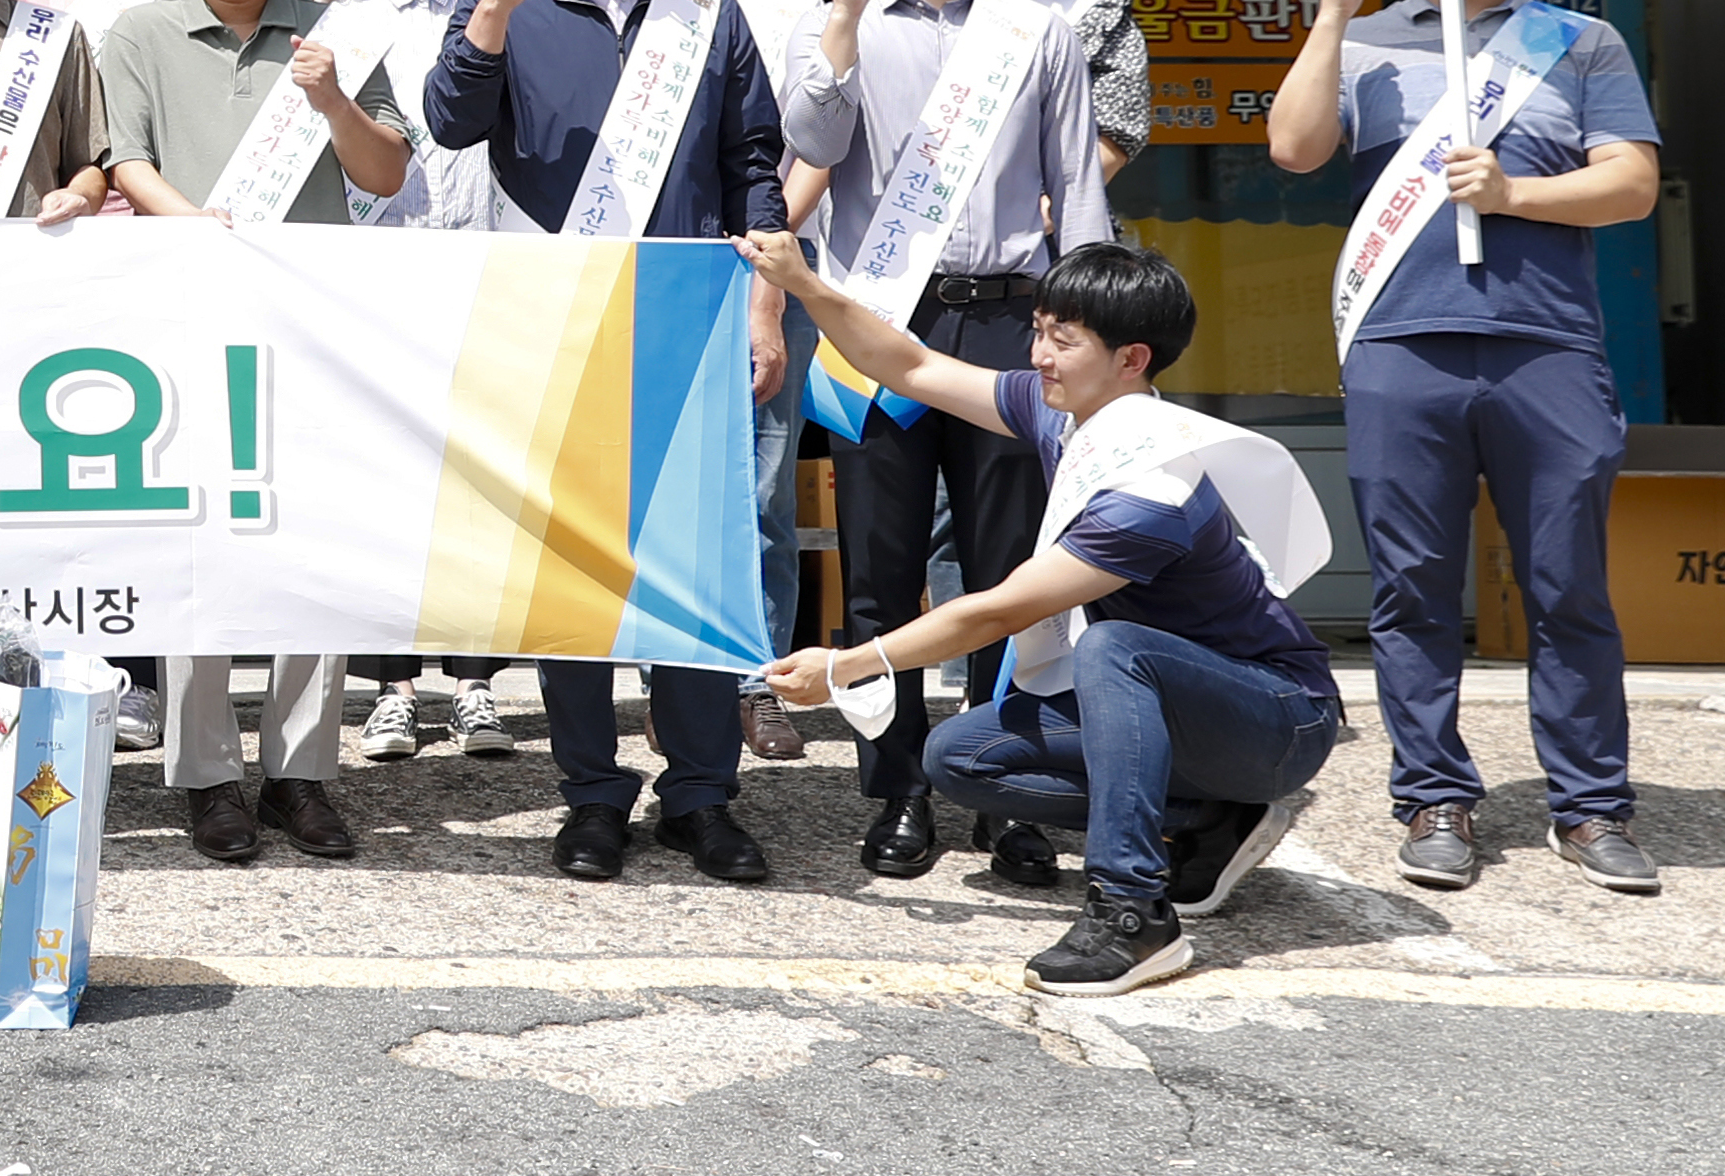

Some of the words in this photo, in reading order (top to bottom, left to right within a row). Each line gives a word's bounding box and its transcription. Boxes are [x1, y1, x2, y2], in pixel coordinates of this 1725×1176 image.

[25, 7, 55, 44] 우리
[678, 19, 709, 60] 우리
[619, 48, 667, 132] 영양가득
[661, 60, 693, 105] 함께
[986, 50, 1018, 93] 우리
[915, 81, 972, 168] 영양가득
[964, 93, 1000, 139] 함께
[597, 135, 635, 178] 진도
[627, 108, 676, 189] 소비해요
[890, 168, 931, 215] 진도
[918, 142, 975, 225] 소비해요
[1376, 175, 1427, 237] 소비에
[862, 217, 908, 285] 수산물
